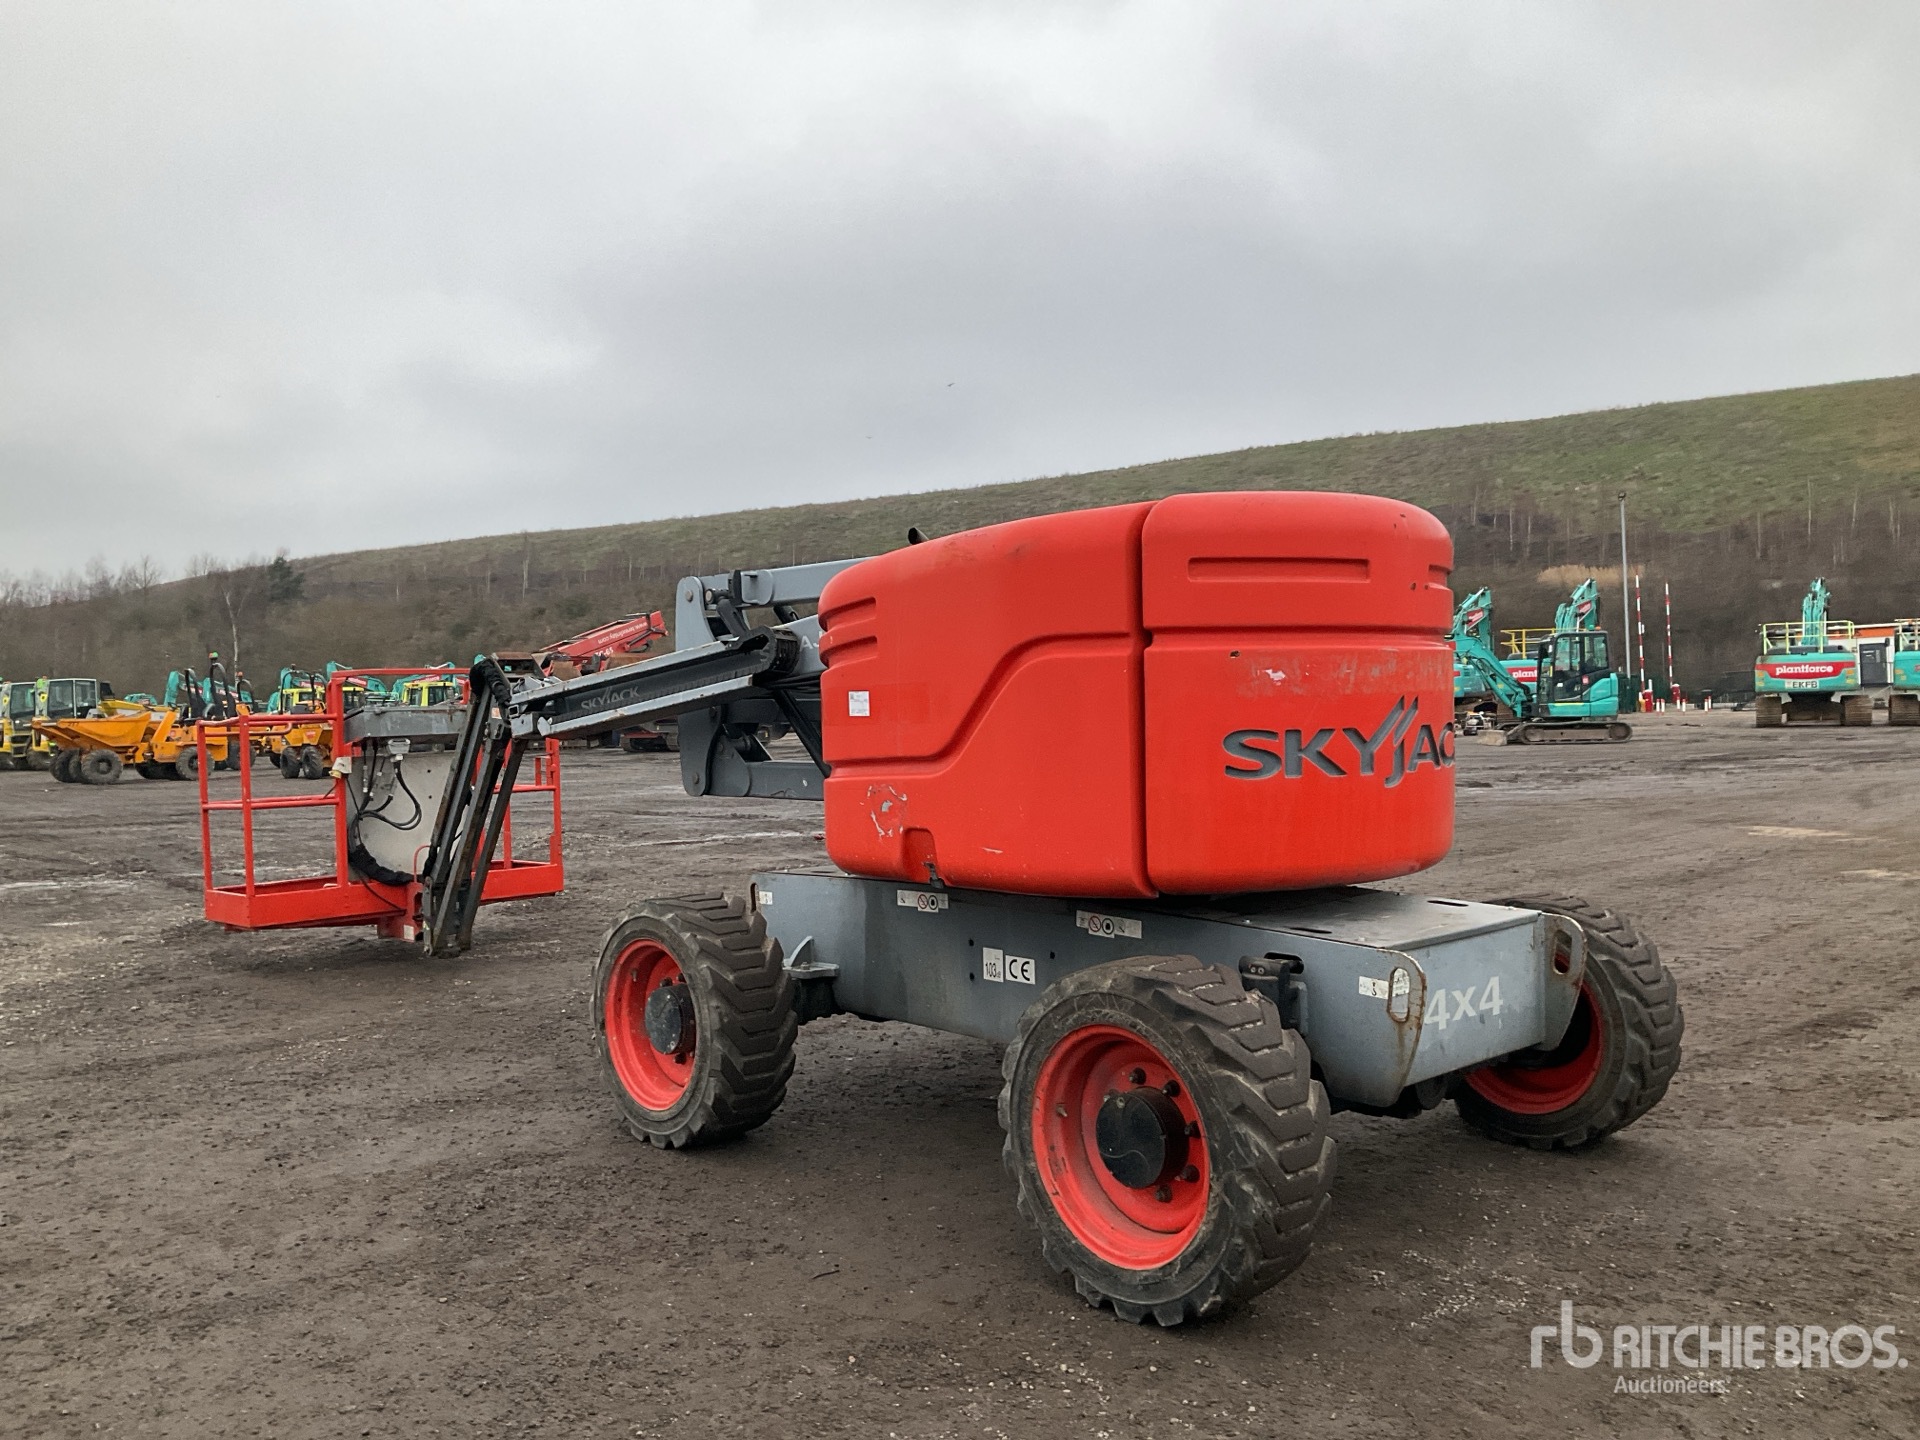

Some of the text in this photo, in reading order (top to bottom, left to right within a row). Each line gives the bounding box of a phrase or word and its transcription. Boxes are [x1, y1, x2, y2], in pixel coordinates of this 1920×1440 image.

[1775, 664, 1834, 676] plantforce
[581, 685, 640, 711] SKYJACK
[1009, 958, 1031, 982] CE
